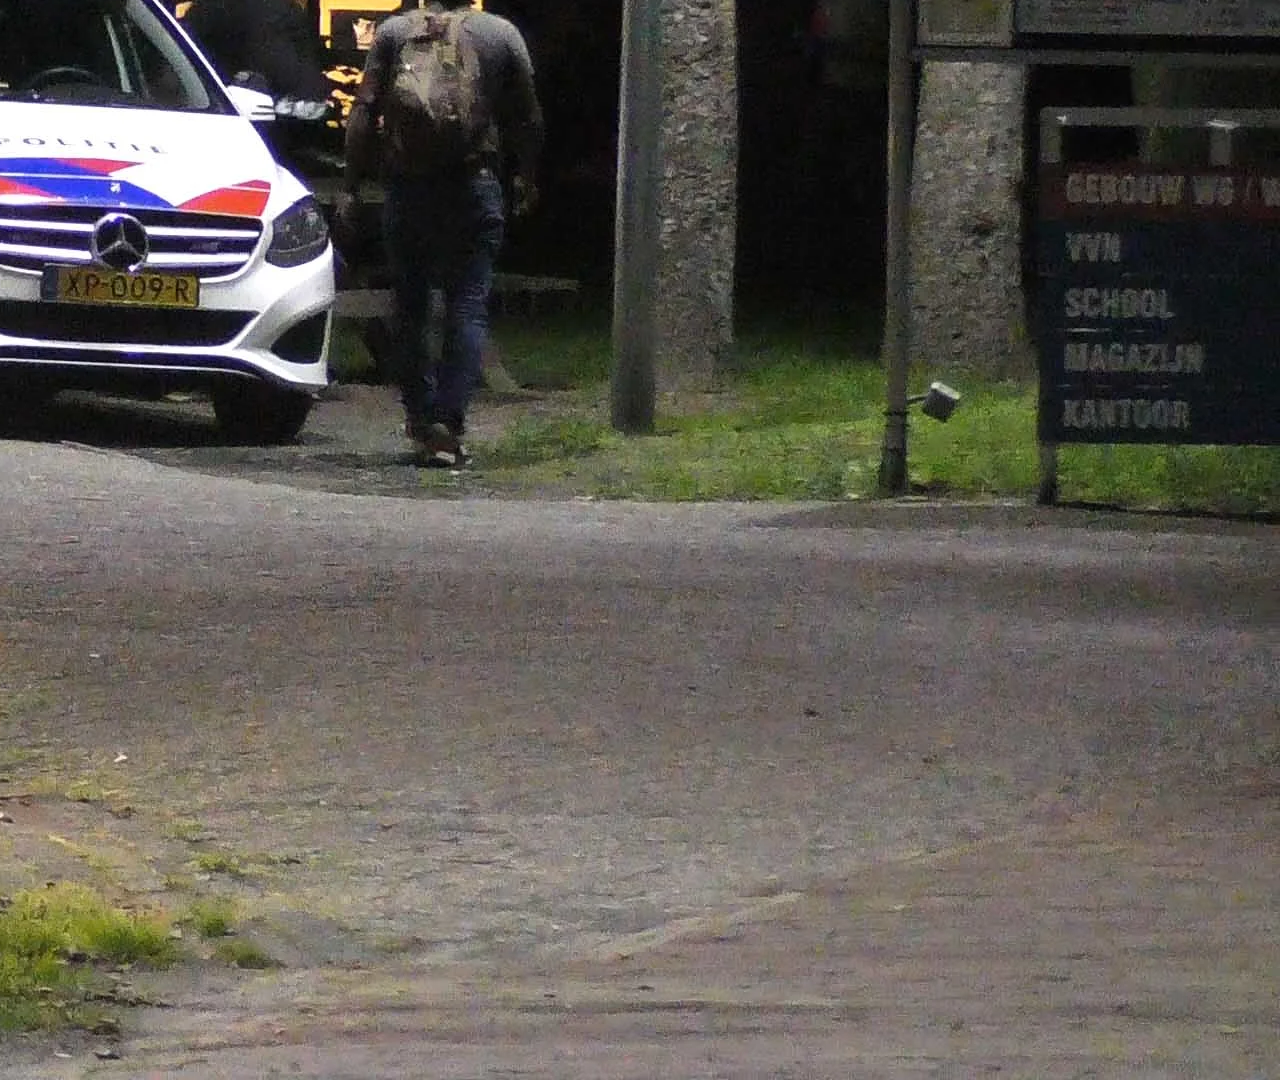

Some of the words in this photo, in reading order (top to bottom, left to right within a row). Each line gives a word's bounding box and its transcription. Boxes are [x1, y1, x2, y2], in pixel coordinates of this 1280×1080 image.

[1066, 173, 1185, 205] GEBOUW
[65, 271, 190, 303] XP-009-R
[1064, 288, 1176, 319] SCHOOL
[1063, 343, 1205, 372] MAGAZIJN
[1063, 400, 1191, 429] KANTOOR
